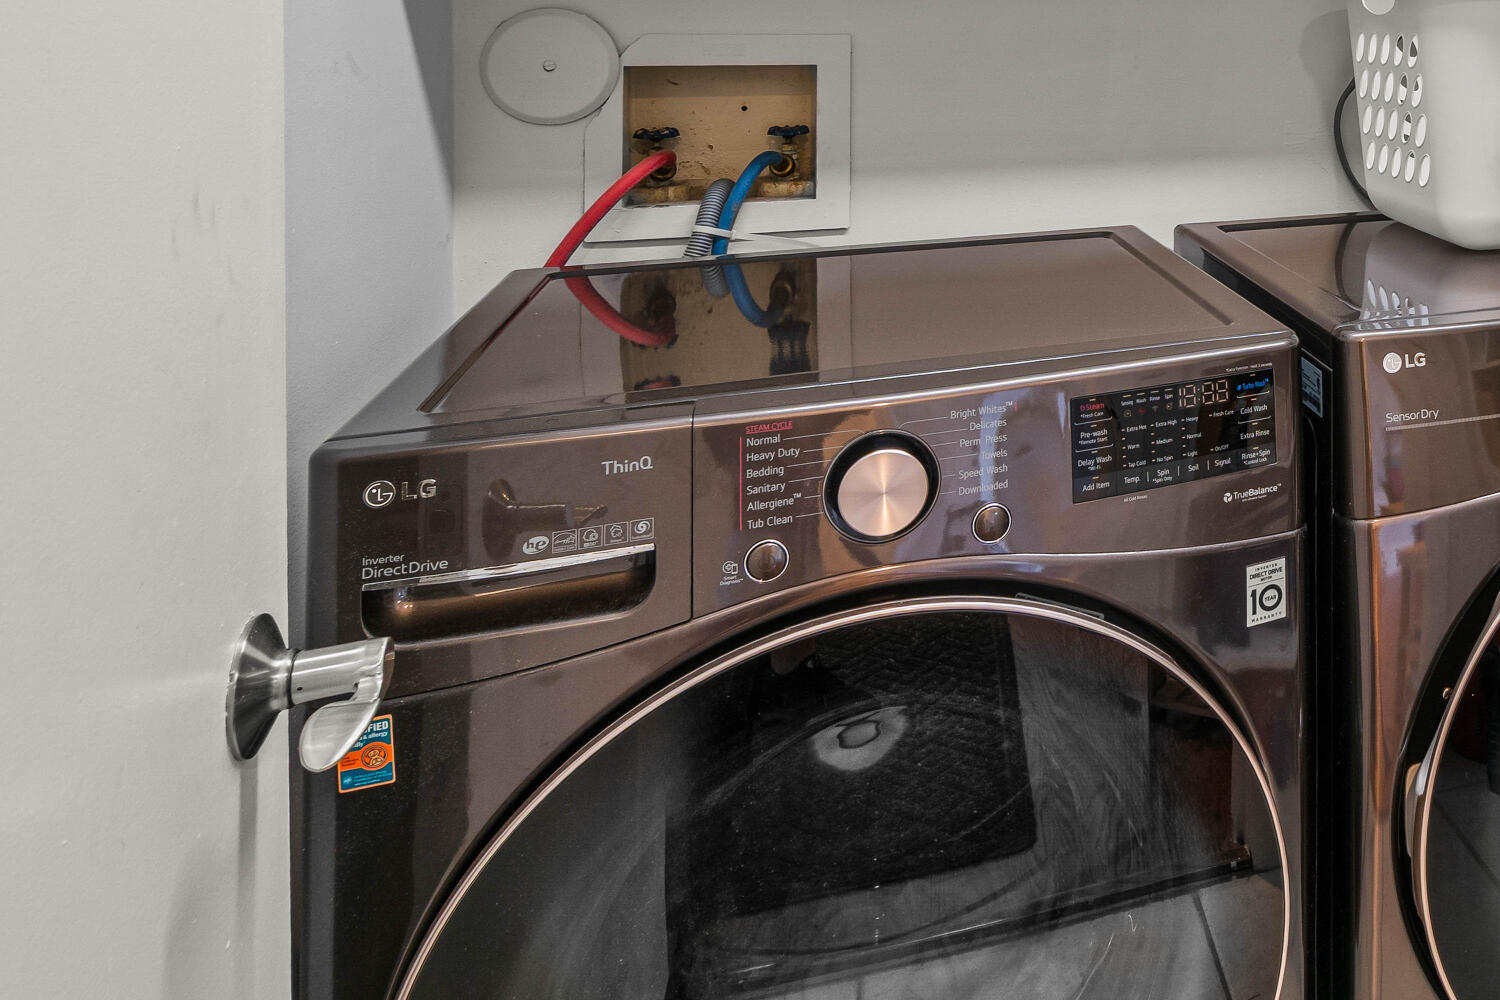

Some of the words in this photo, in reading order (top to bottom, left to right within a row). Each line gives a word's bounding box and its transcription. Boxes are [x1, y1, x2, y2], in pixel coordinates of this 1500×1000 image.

[1404, 352, 1426, 368] LG
[1086, 403, 1105, 411] Steam
[1240, 407, 1253, 415] Cold
[1254, 404, 1268, 412] Wash
[950, 409, 976, 420] Bright
[745, 424, 769, 434] STEAM
[771, 421, 792, 431] CYCLE
[969, 419, 1007, 431] Delicates
[1168, 419, 1177, 427] High
[1080, 428, 1107, 438] Pre-wash
[1240, 432, 1254, 440] Extra
[1255, 429, 1270, 437] Rinse
[746, 434, 781, 447] Normal
[985, 434, 1008, 445] Press
[981, 448, 1008, 460] Towels
[1215, 444, 1229, 452] On/Off
[1242, 449, 1271, 459] Rinse+Spin
[746, 451, 775, 463] Heavy
[778, 447, 800, 460] Duty
[1078, 458, 1095, 467] Delay
[1096, 455, 1112, 464] Wash
[601, 455, 653, 475] ThinQ
[1188, 464, 1199, 472] Soil
[1214, 457, 1231, 467] Signal
[746, 466, 784, 479] Bedding
[958, 468, 983, 480] Speed
[986, 464, 1008, 474] Wash
[1157, 468, 1169, 477] Spin
[400, 478, 437, 501] LG
[746, 481, 786, 495] Sanitary
[958, 480, 1009, 496] Downloaded
[1082, 483, 1095, 492] Add
[1096, 481, 1110, 489] Item
[747, 519, 764, 530] Tub
[767, 514, 793, 527] Clean
[362, 553, 405, 567] Inverter
[1249, 571, 1267, 580] DIRECT
[1268, 567, 1283, 575] DRIVE
[1255, 563, 1278, 572] INVERTER
[1250, 584, 1283, 616] 10
[1264, 594, 1277, 602] YEAR
[1251, 611, 1282, 623] WARRANTY
